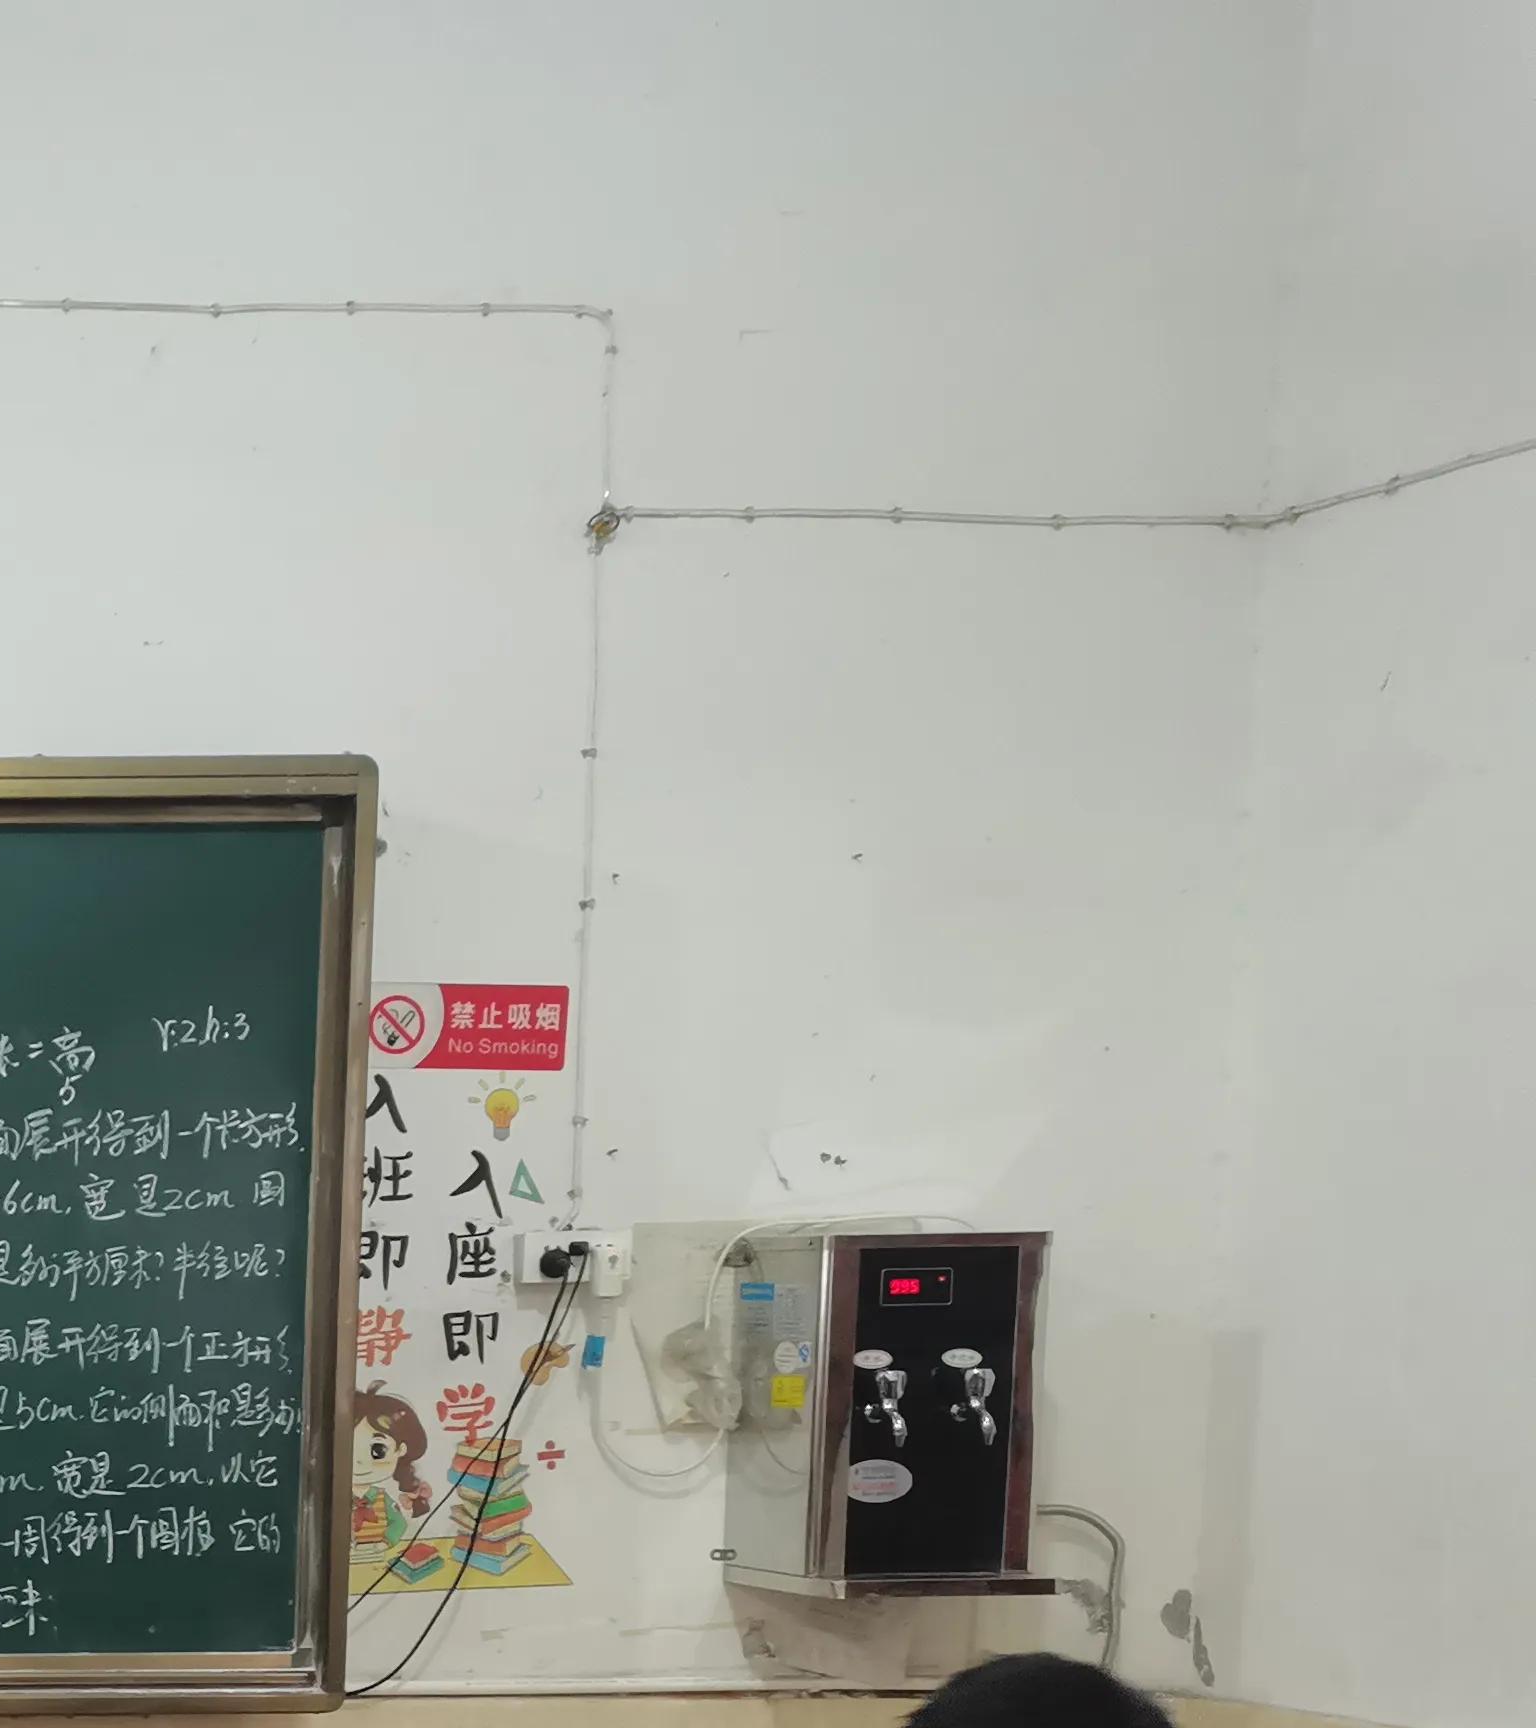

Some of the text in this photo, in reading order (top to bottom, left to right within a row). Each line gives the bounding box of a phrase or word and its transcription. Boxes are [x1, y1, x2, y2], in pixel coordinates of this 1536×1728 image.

[449, 1001, 562, 1031] 禁止吸烟
[448, 1037, 560, 1058] No Smoking
